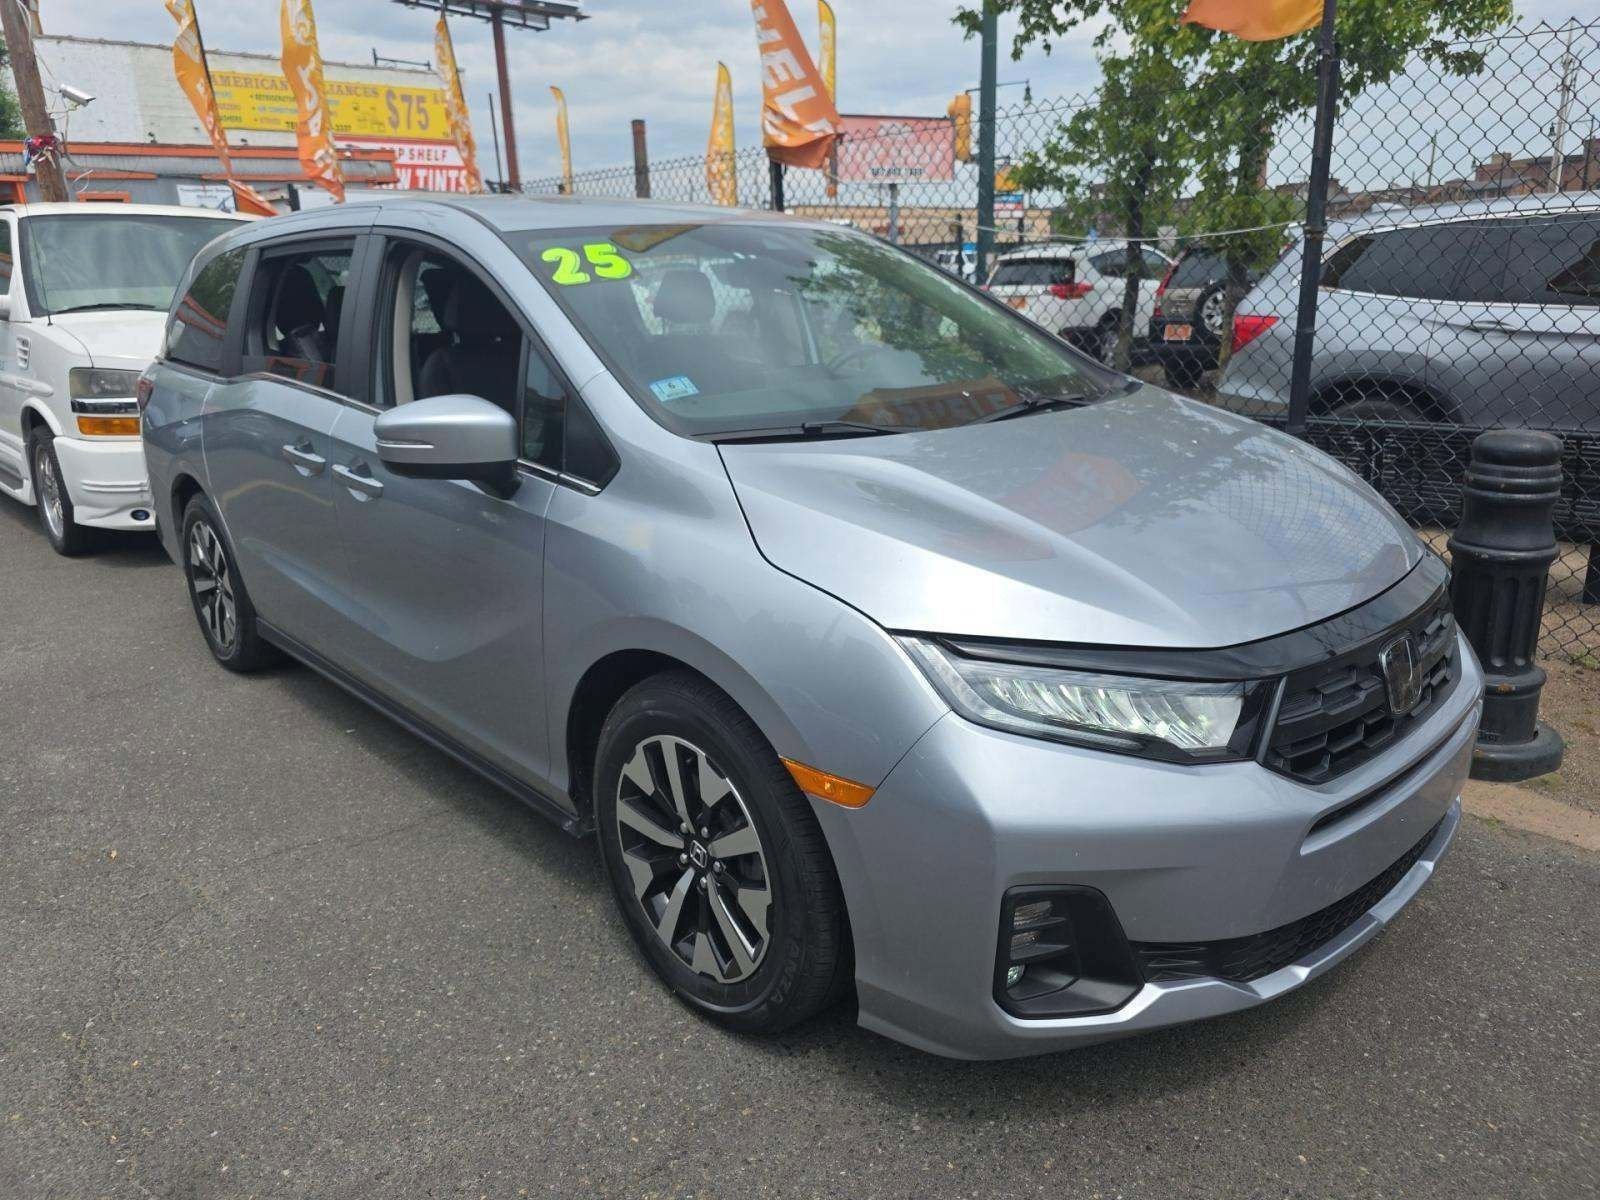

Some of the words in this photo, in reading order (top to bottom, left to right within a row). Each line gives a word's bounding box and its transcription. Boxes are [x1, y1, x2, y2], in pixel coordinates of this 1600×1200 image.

[386, 88, 430, 135] $75
[408, 148, 448, 161] SHELF
[541, 243, 632, 285] 25
